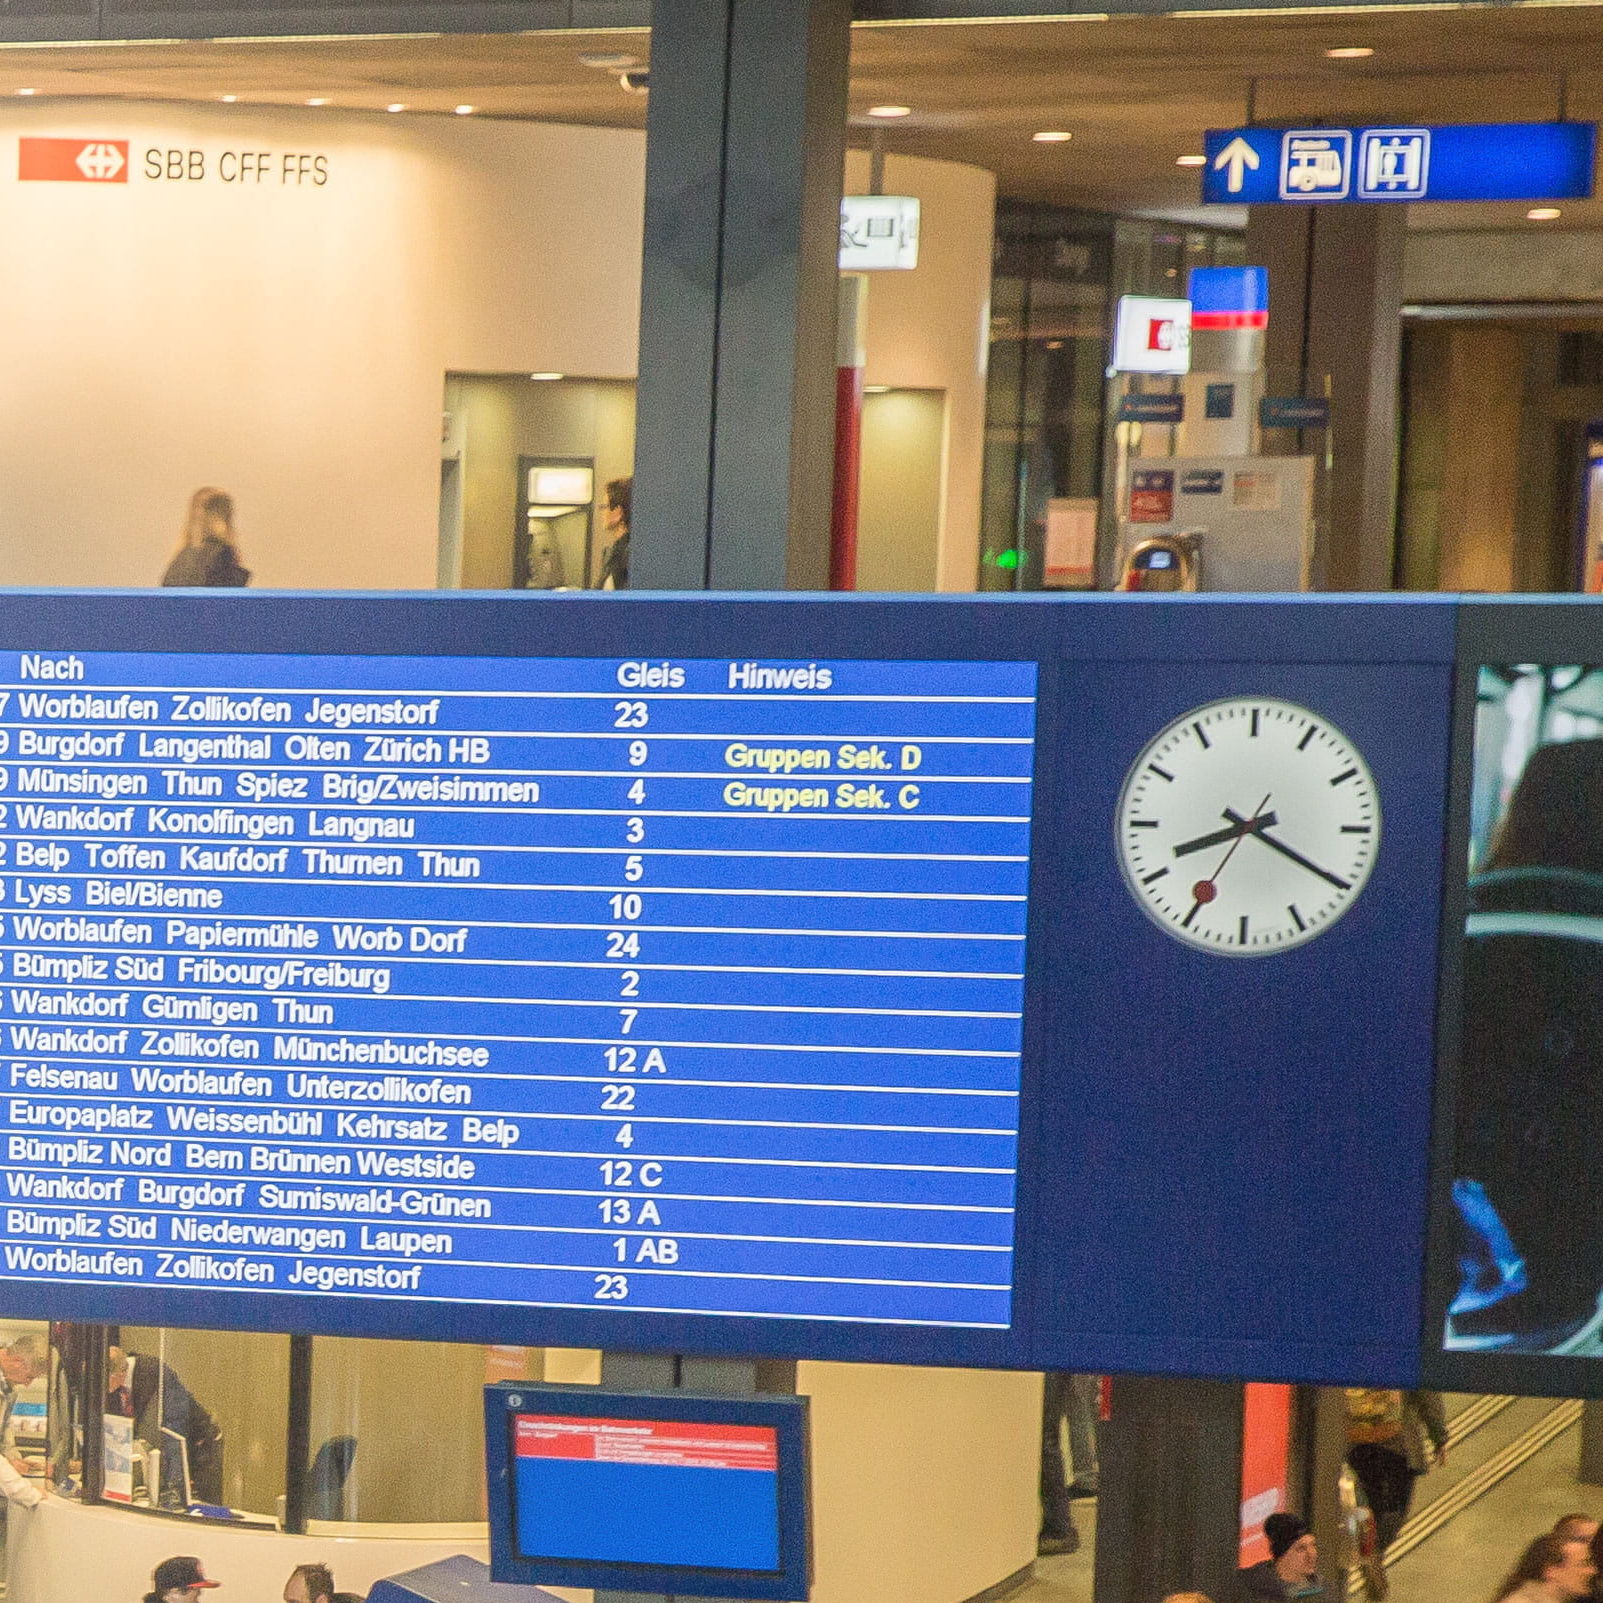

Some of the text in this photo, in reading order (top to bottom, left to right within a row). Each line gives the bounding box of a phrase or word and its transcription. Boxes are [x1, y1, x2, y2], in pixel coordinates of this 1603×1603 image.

[144, 148, 329, 187] SBB CFF FFS
[20, 653, 83, 679] Nach
[617, 661, 685, 687] Gleis
[728, 662, 832, 689] Hinweis
[17, 692, 158, 720] Worblaufen
[170, 694, 291, 721] Zollikofen
[304, 696, 440, 726] Jegenstorf
[18, 729, 490, 763] Burgdorf Langenthal Olten Zürich HB
[724, 742, 922, 770] Gruppen Sek. D
[17, 766, 539, 802] Münsingen Thun Spiez Brig/Zweisimmen
[722, 781, 920, 809] Gruppen Sek. C
[14, 803, 415, 839] Wankdorf Konolfingen Langnau
[15, 841, 70, 874] Belp
[83, 842, 165, 869] Toffen
[179, 845, 289, 872] Kaufdorf
[416, 850, 480, 877] Thun
[14, 877, 223, 911] Lyss Biel/Bienne
[12, 915, 468, 952] Worblaufen Papiermühle Worb Dorf
[12, 951, 390, 993] Bümpliz Süd Fribourg/Freiburg
[10, 988, 333, 1025] Wankdorf Gümligen Thun
[9, 1025, 129, 1054] Wankdorf
[139, 1030, 259, 1058] Zollikofen
[273, 1035, 489, 1067] Münchenbuchsee
[10, 1062, 471, 1104] Felsenau Worblaufen Unterzollikofen
[9, 1098, 519, 1148] Europaplatz Weissenbühl Kehrsatz Belp
[8, 1135, 475, 1179] Bümpliz Nord Bern Brünnen Westside
[5, 1172, 125, 1201] Wankdorf
[138, 1178, 246, 1210] Burgdorf
[258, 1183, 491, 1218] Sumiswald-Grünen
[6, 1208, 452, 1256] Bümpliz Süd Niederwangen Laupen
[4, 1245, 143, 1276] Worblaufen
[155, 1252, 274, 1282] Zollikofen
[287, 1259, 422, 1290] Jegenstorf
